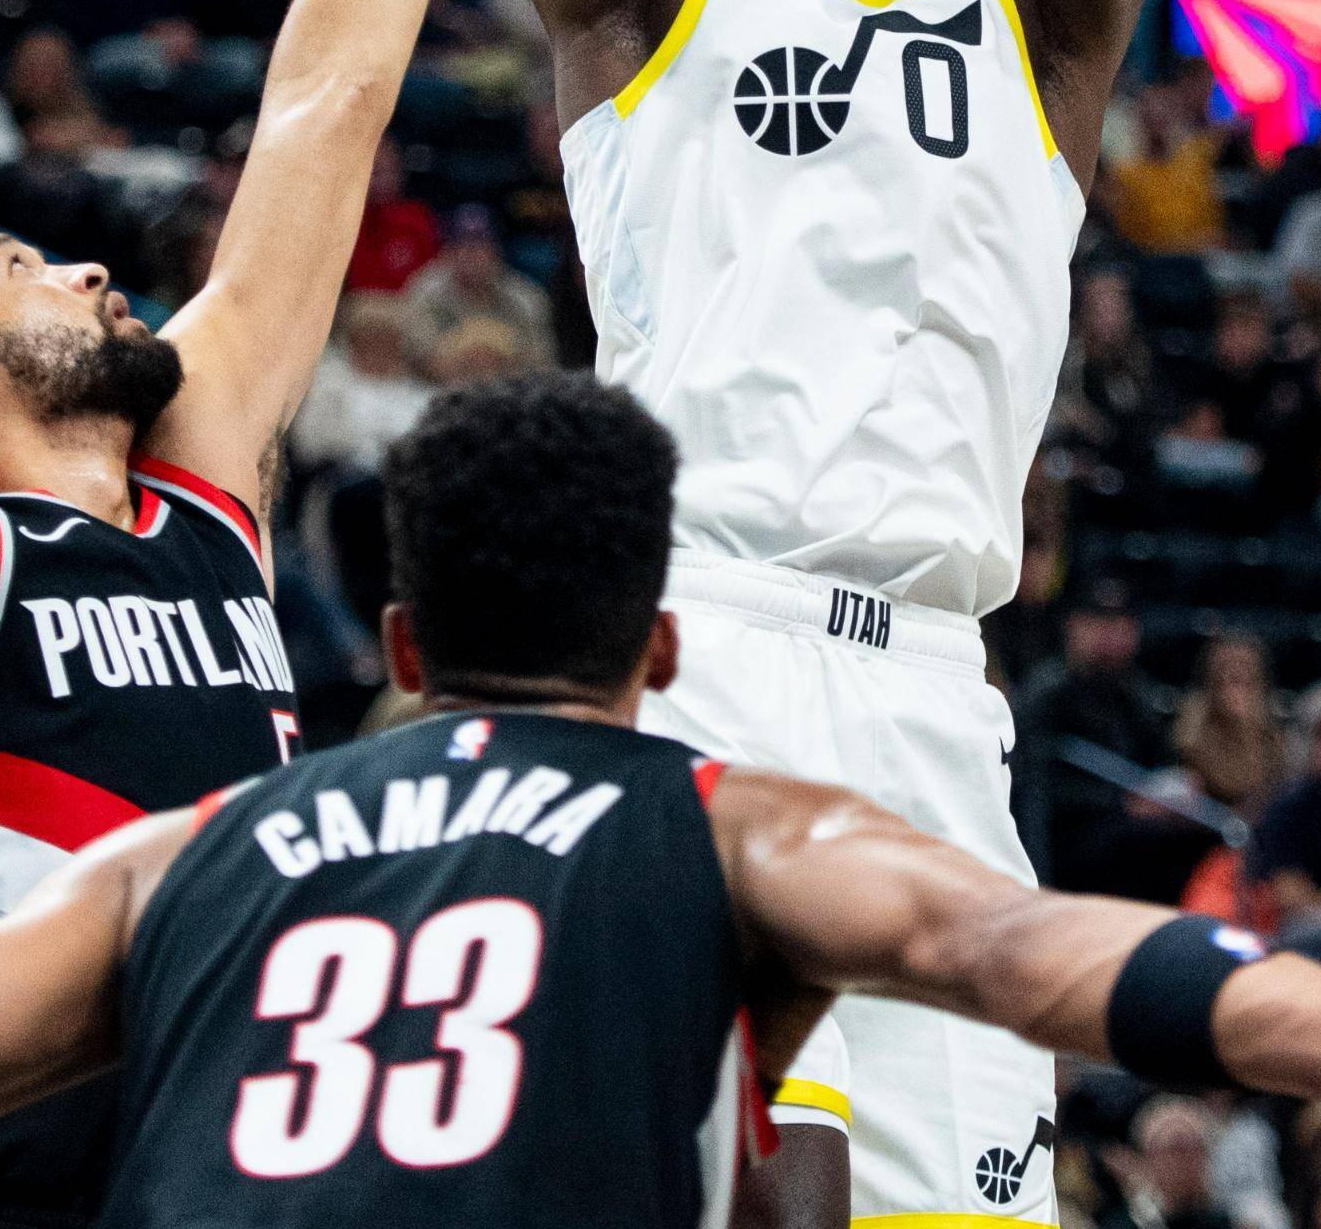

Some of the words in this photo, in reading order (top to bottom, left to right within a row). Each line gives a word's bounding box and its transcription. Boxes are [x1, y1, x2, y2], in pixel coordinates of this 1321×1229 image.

[901, 39, 969, 159] 0
[827, 587, 891, 650] UTAH
[252, 764, 625, 879] CAMARA
[228, 895, 545, 1179] 33
